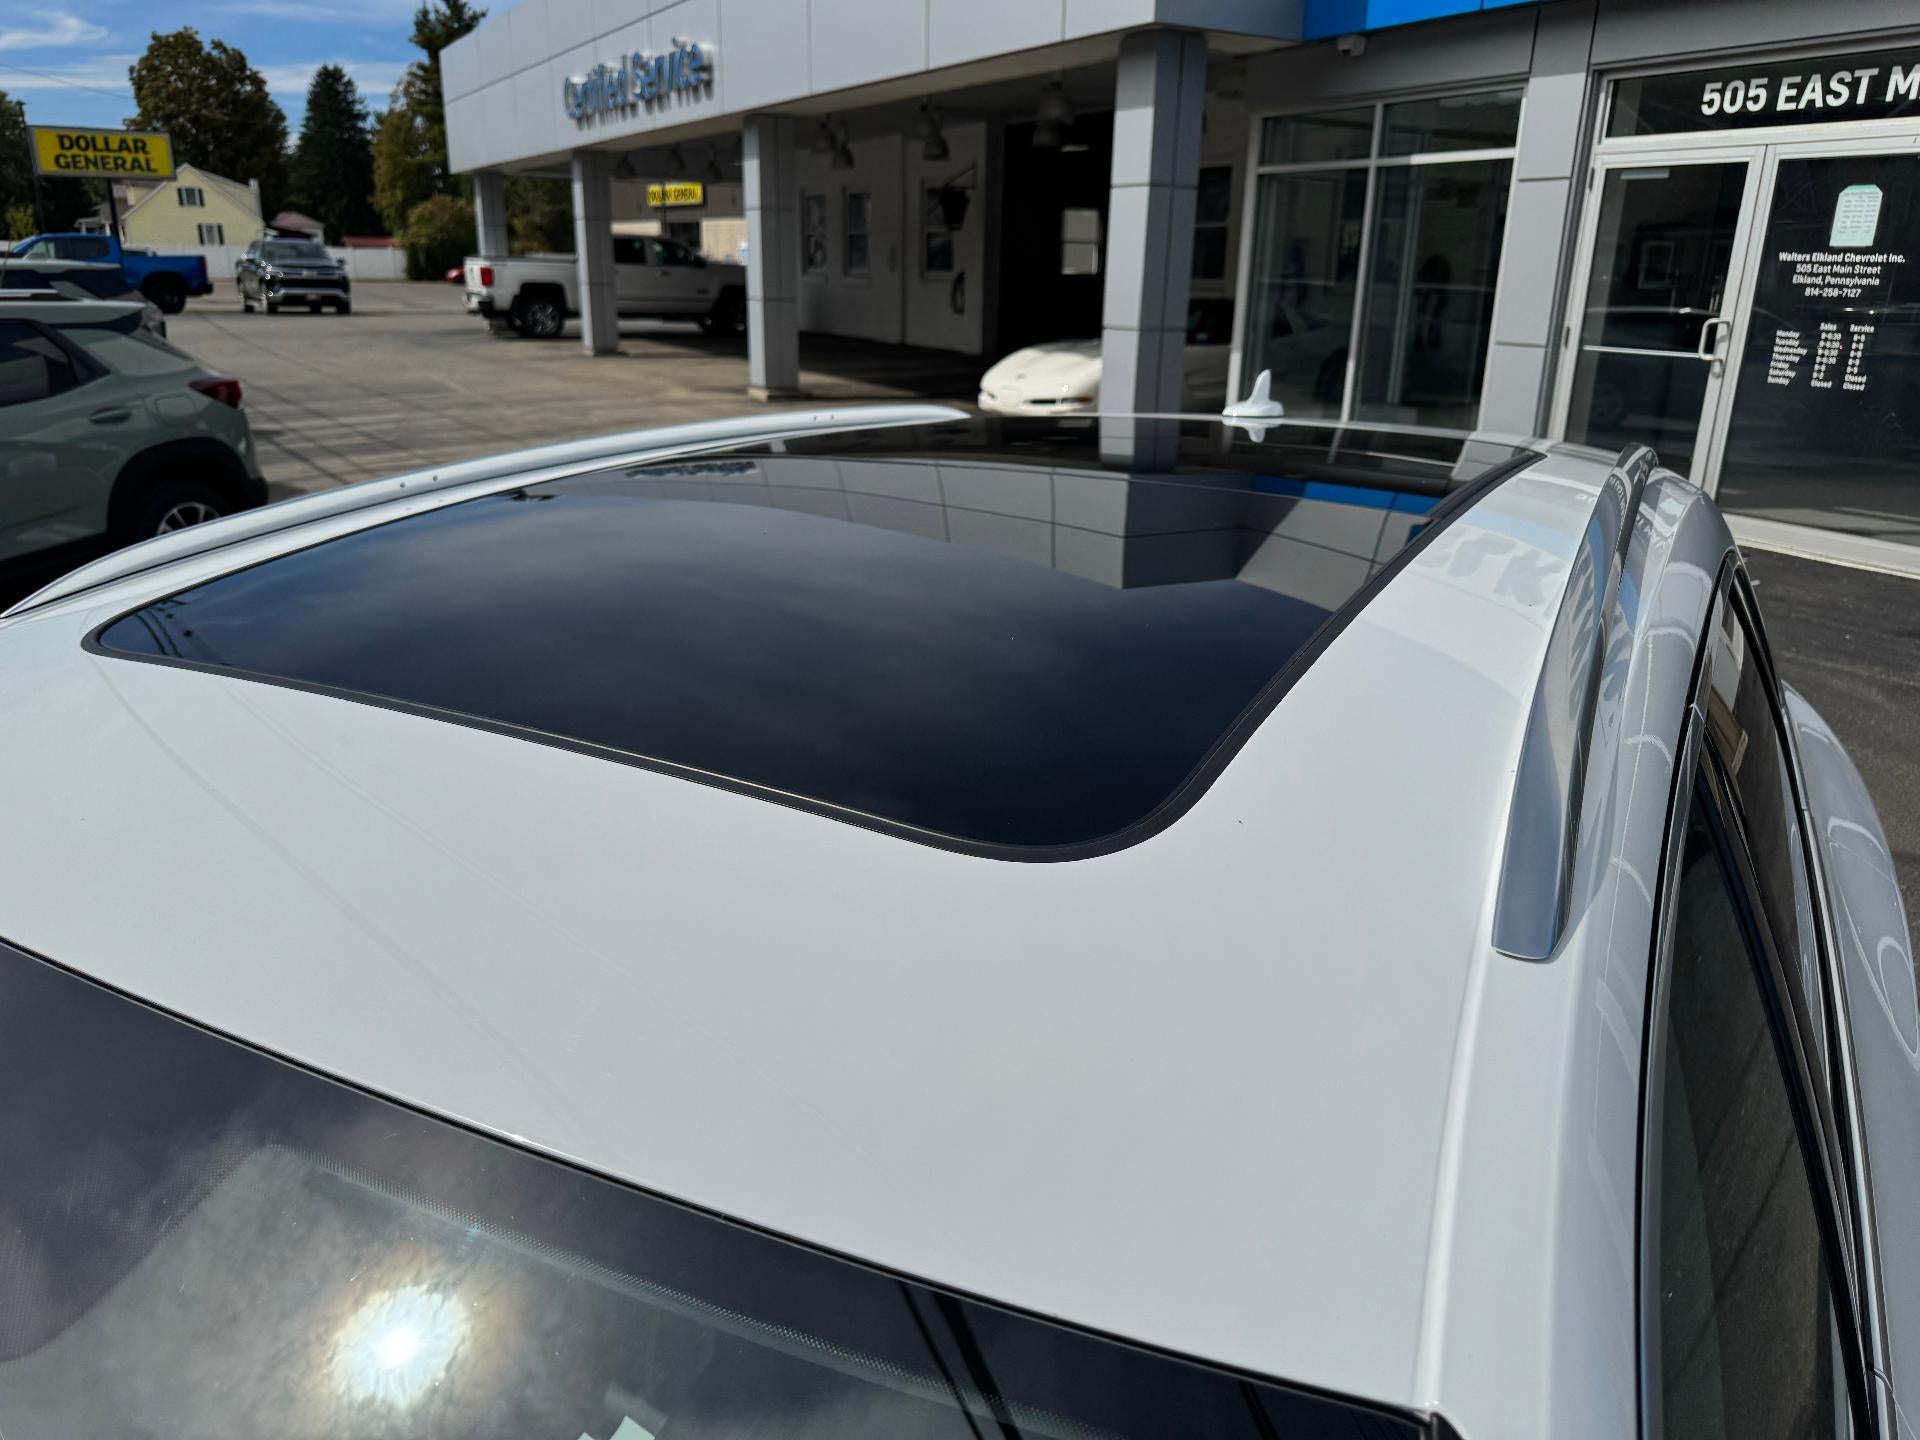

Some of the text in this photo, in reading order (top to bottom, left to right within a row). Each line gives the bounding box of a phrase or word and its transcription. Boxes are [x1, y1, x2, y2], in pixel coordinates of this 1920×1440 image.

[1701, 78, 1768, 115] 505
[1776, 68, 1879, 111] EAST
[56, 134, 149, 154] DOLLAR
[54, 153, 157, 173] GENERAL
[1779, 252, 1906, 263] Walters Elkland Chevrolet Inc.
[1796, 263, 1881, 275] 505 East Main Street
[1824, 275, 1880, 287] Pennsylvania
